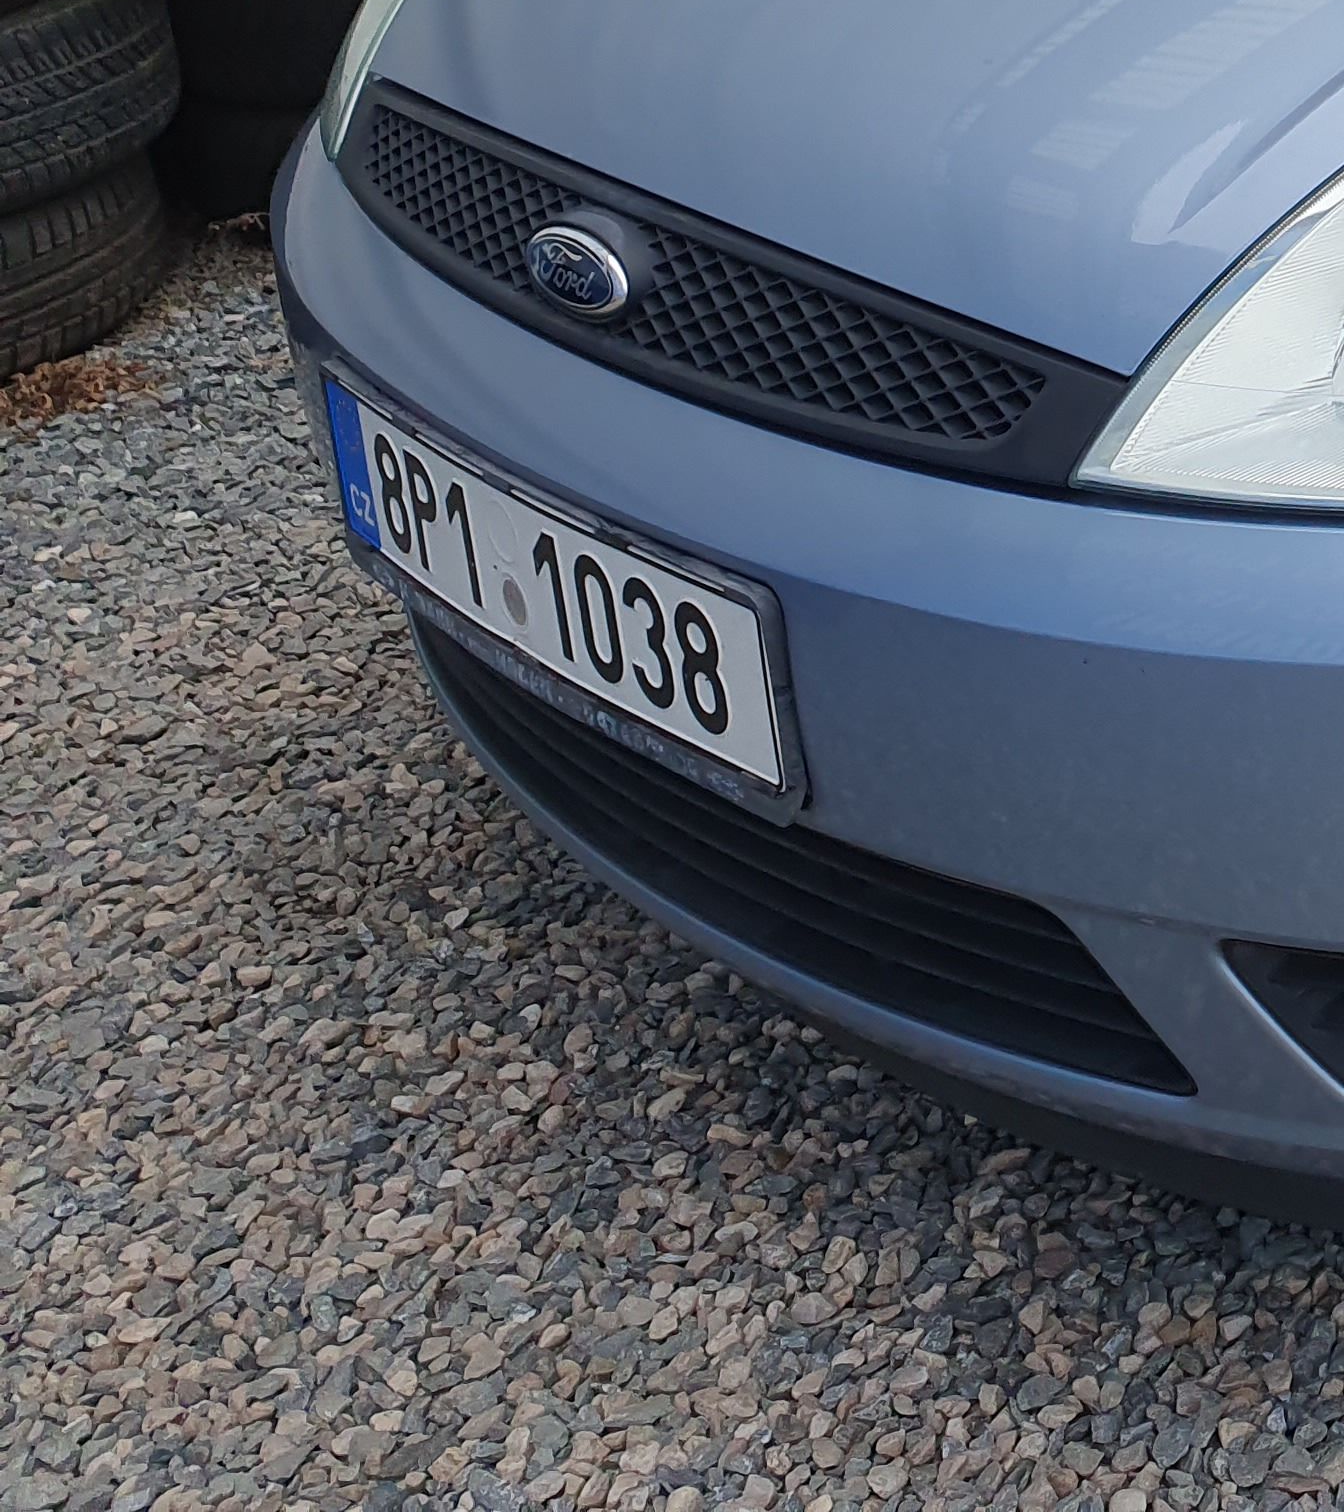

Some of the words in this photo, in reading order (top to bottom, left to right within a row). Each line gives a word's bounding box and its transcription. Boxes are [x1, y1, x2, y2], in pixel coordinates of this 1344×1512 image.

[541, 242, 593, 301] Ford
[348, 482, 377, 529] CZ
[373, 432, 483, 608] 8P1
[532, 528, 730, 736] 1038
